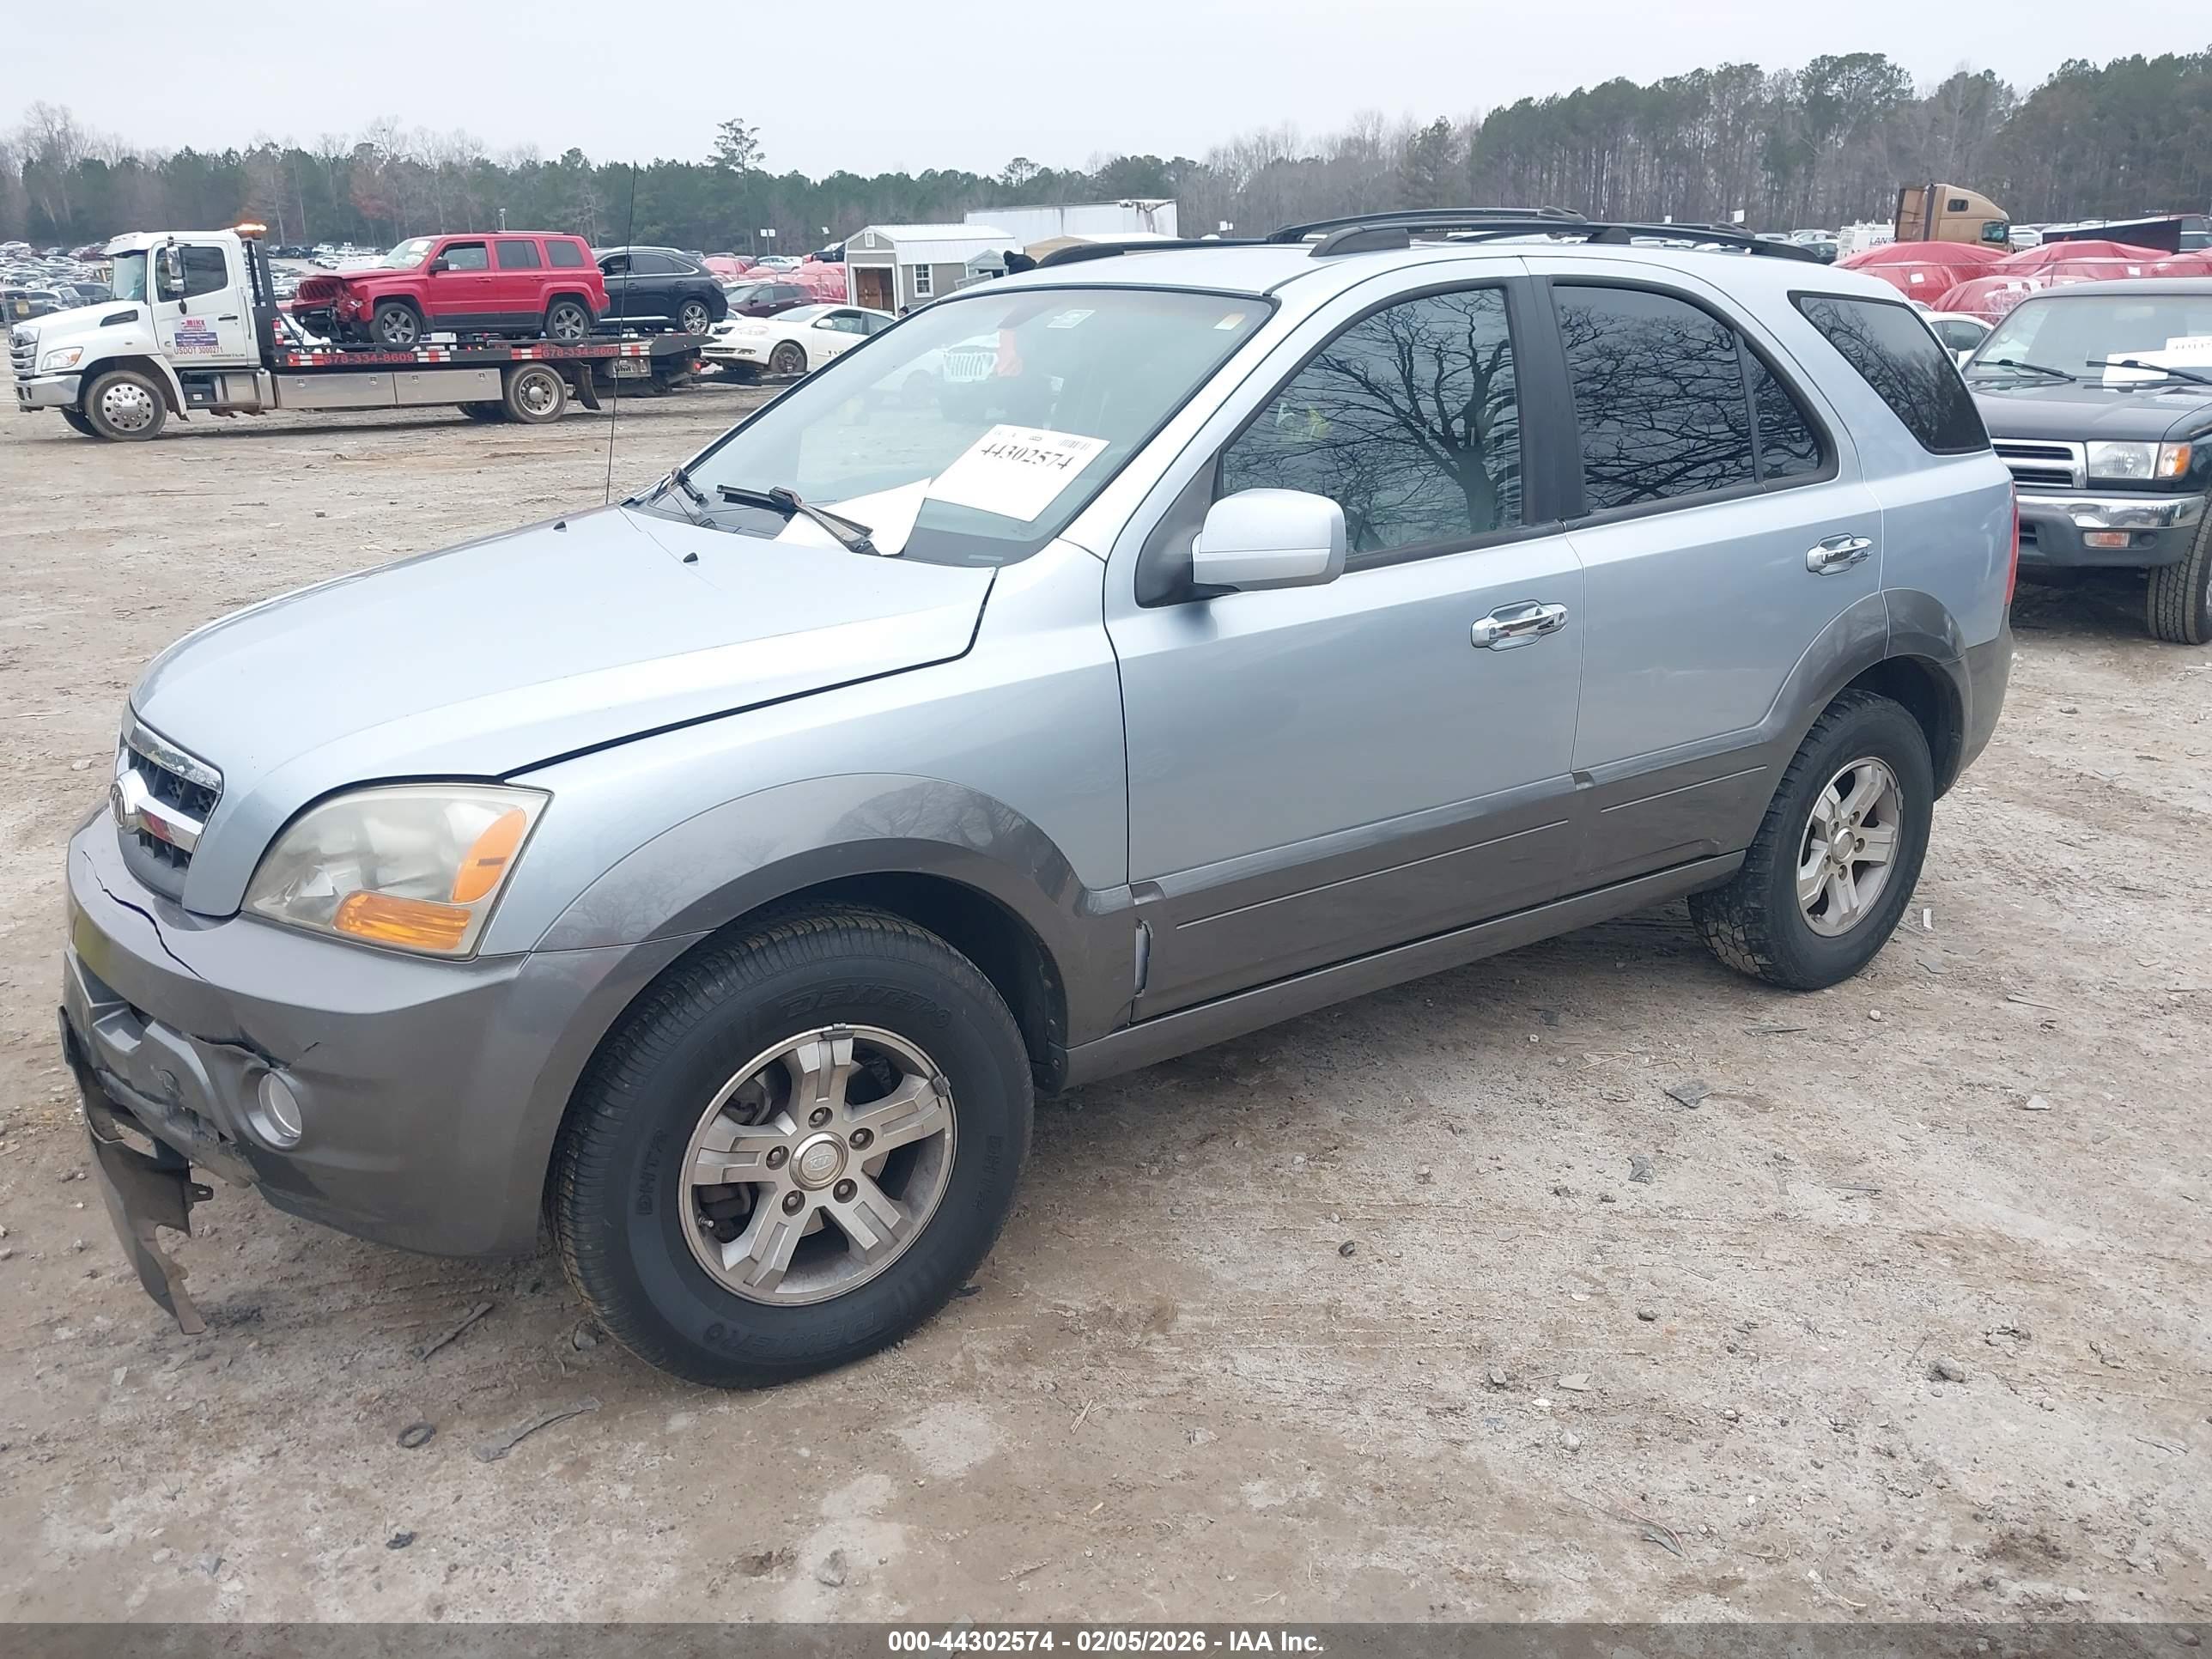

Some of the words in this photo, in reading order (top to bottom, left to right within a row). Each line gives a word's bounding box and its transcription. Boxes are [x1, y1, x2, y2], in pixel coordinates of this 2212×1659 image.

[173, 346, 197, 355] USDOT
[324, 352, 415, 364] 678-334-8609
[981, 443, 1076, 470] 44302574
